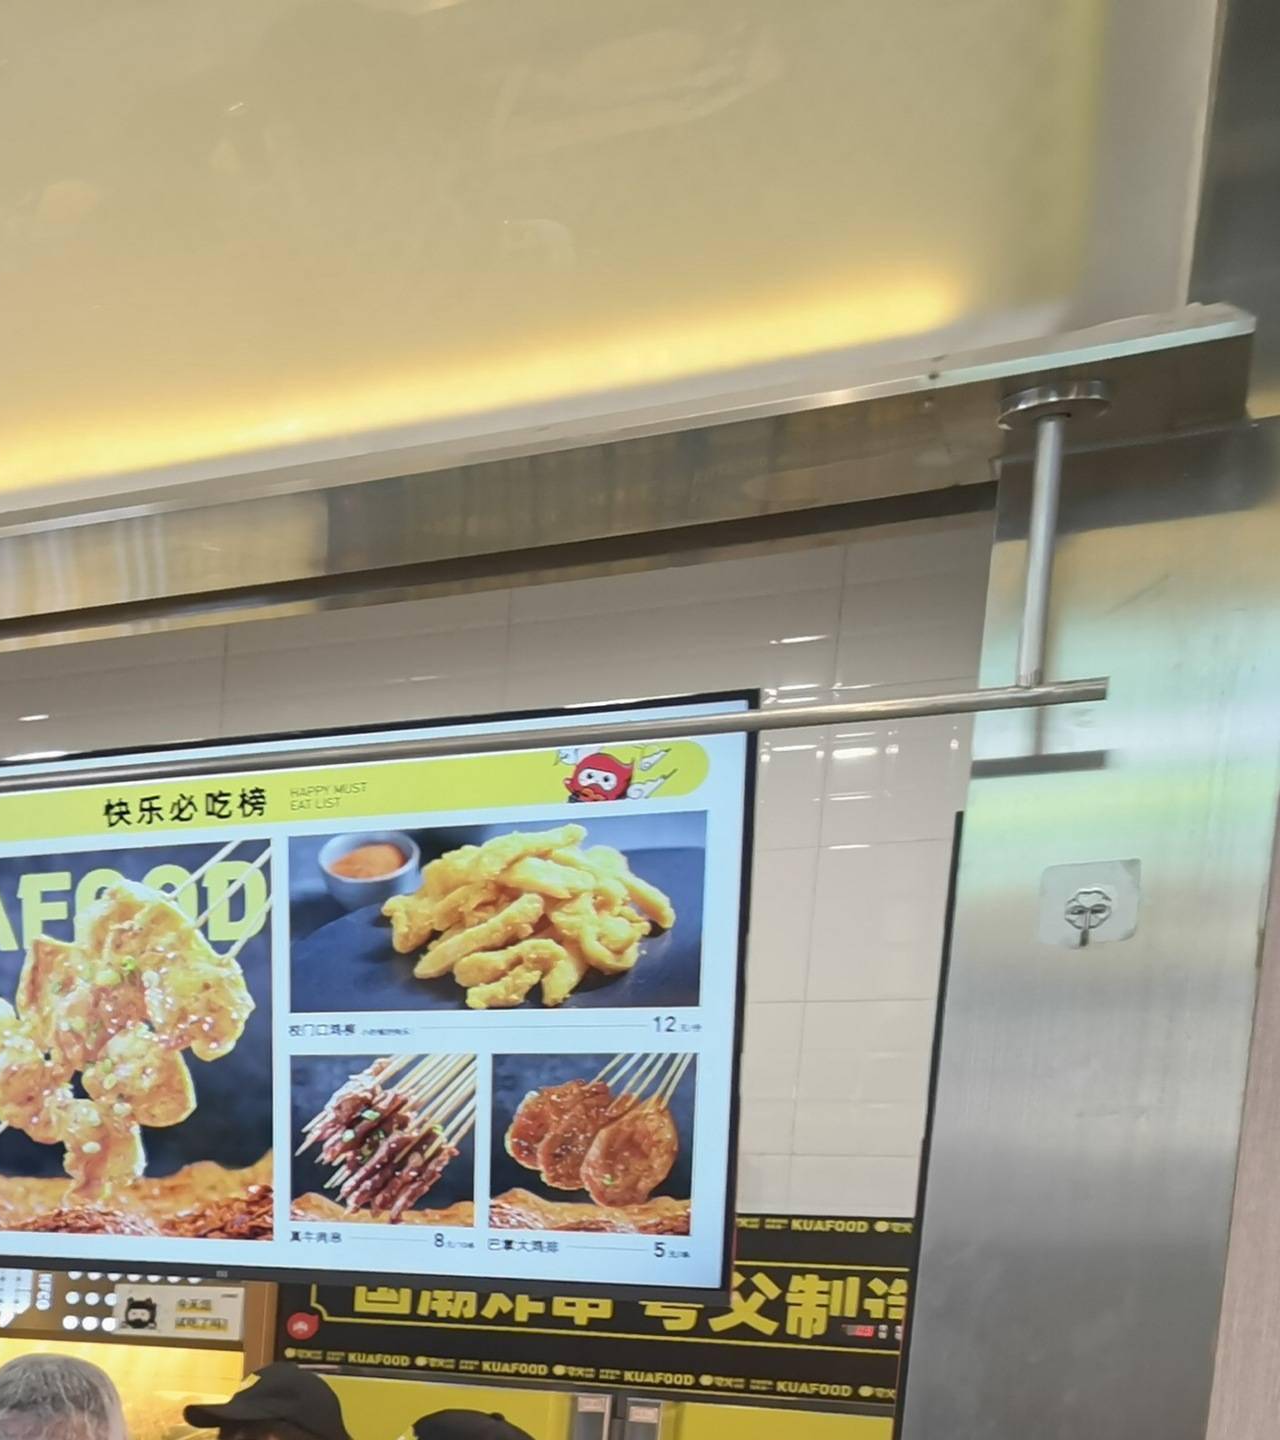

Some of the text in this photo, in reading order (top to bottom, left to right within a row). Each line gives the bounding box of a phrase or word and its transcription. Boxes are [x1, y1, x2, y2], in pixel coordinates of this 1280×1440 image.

[290, 781, 367, 799] HAPPY MUST
[104, 787, 268, 828] 快乐必吃榜
[290, 796, 341, 812] EAT LIST
[653, 1016, 676, 1033] 12
[791, 1219, 869, 1233] KUAFOOD
[433, 1233, 445, 1248] 8
[654, 1242, 666, 1257] 5
[348, 1353, 411, 1366] KUAFOOD
[482, 1361, 548, 1376] KUAFOOD
[623, 1370, 695, 1386] KUAFOOD
[776, 1381, 853, 1397] KUAFOOD
